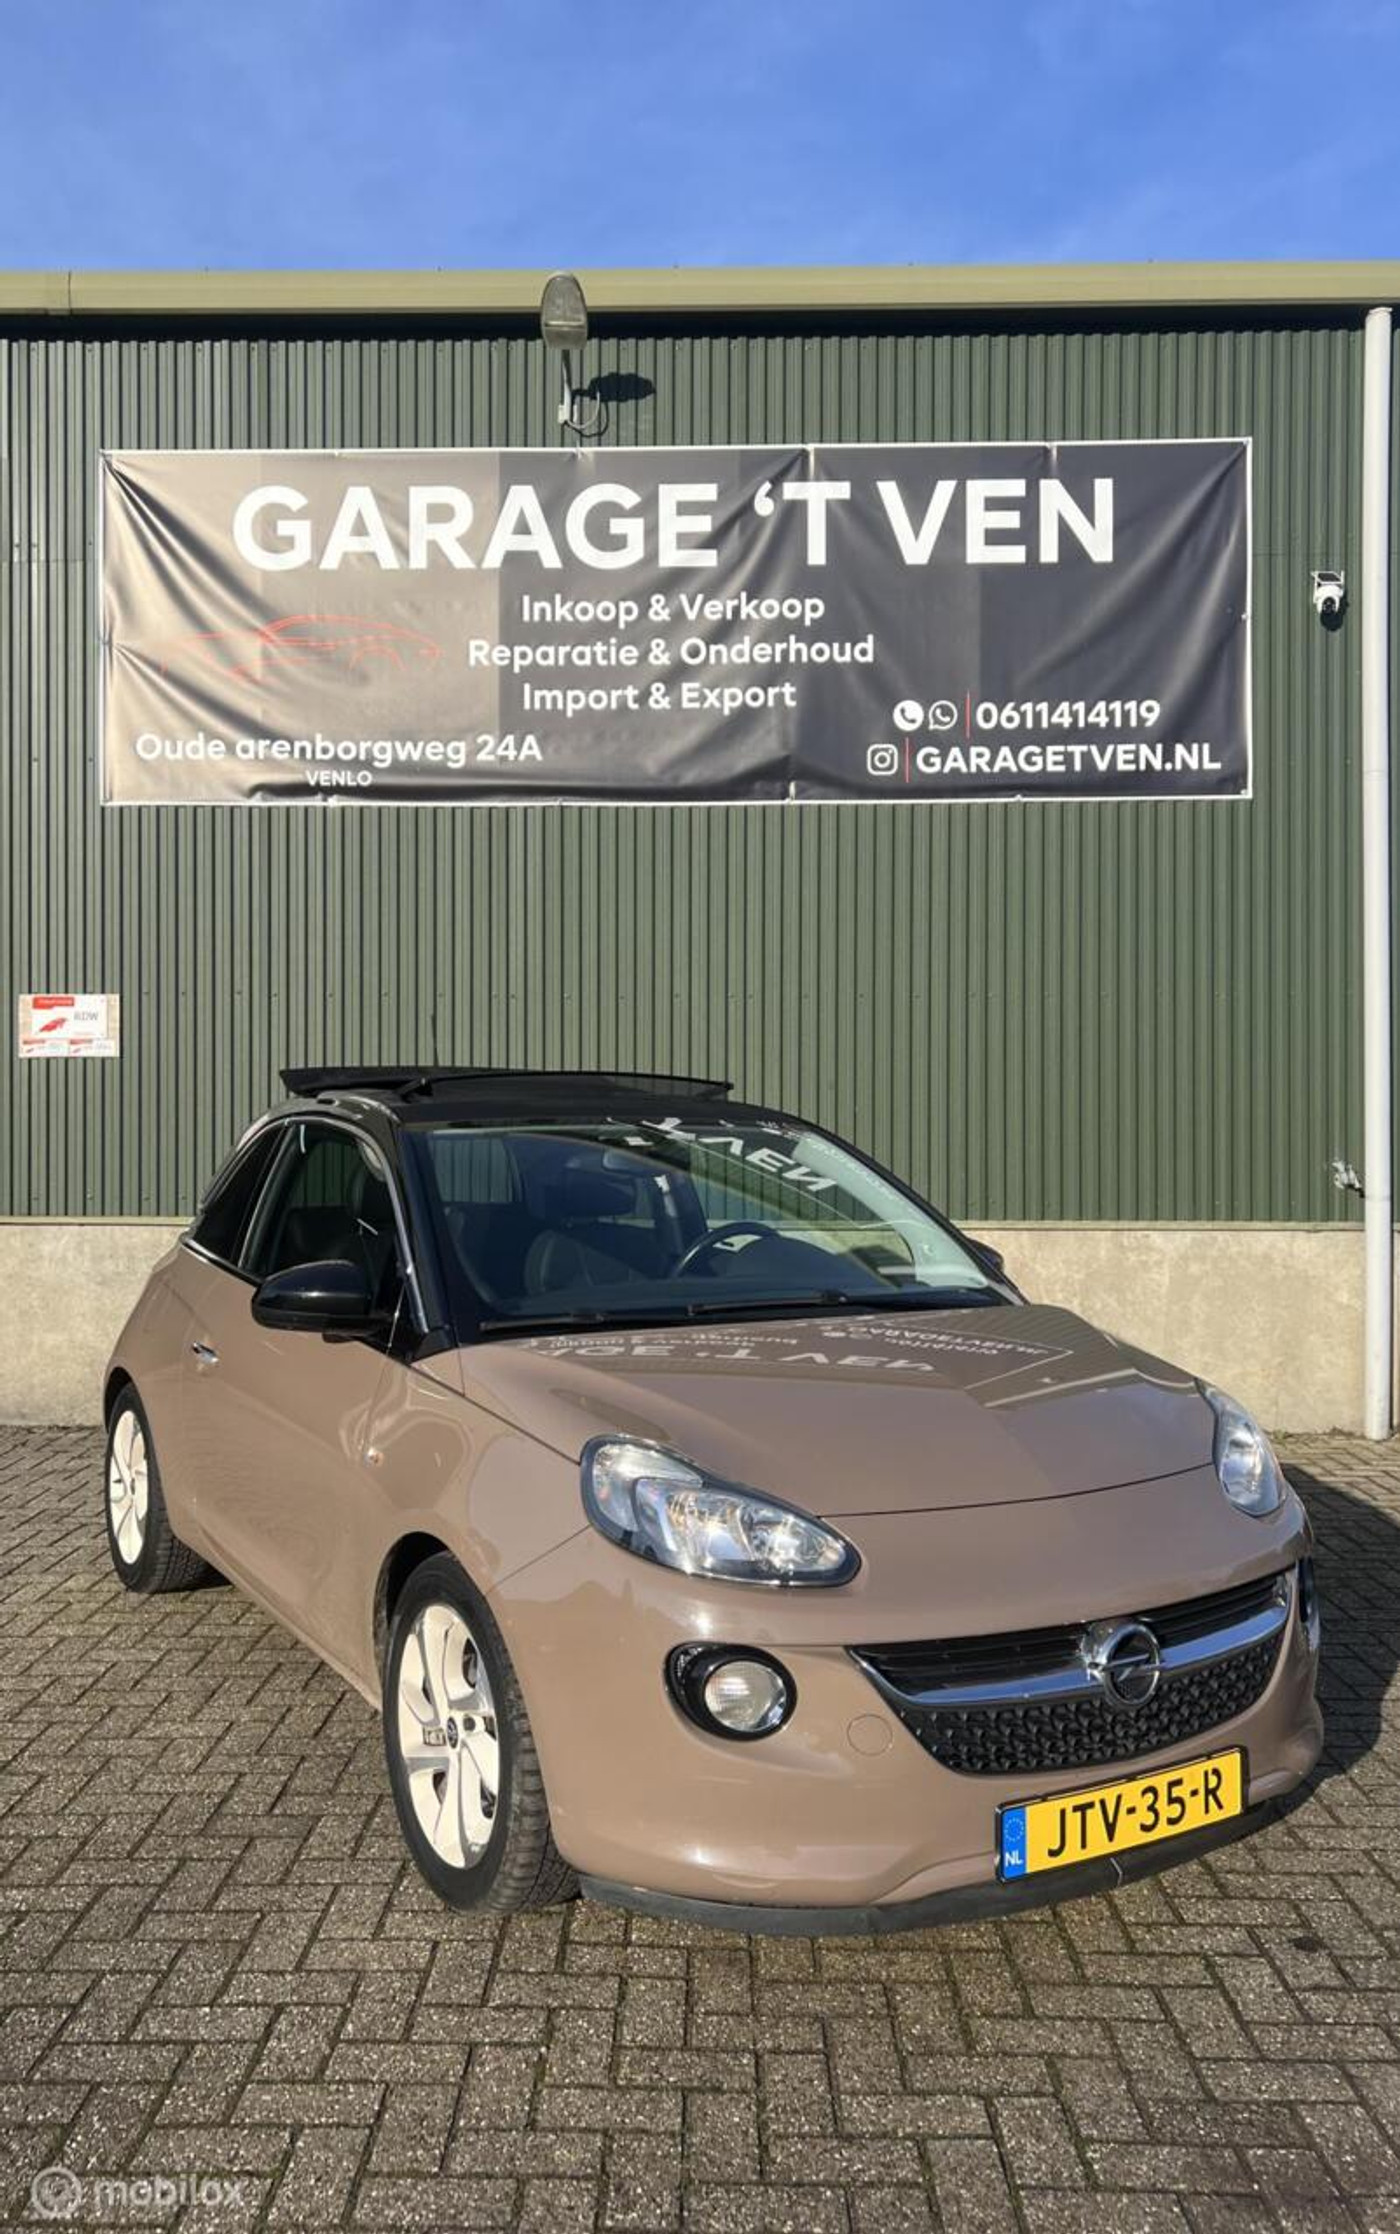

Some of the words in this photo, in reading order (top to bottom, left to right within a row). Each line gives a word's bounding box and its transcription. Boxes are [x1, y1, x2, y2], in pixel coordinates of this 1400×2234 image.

[233, 484, 718, 571] GARAGE
[877, 478, 1114, 565] VEN
[523, 594, 639, 629] Inkoop
[648, 595, 671, 622] &
[680, 592, 825, 626] Verkoop
[469, 637, 639, 673] Reparatie
[648, 639, 671, 665] &
[681, 634, 874, 665] Onderhoud
[523, 683, 639, 715] Import
[648, 683, 671, 710] &
[682, 682, 797, 716] Export
[976, 699, 1161, 730] 0611414119
[136, 732, 226, 760] Oude
[235, 734, 466, 768] arenborgweg
[476, 734, 543, 761] 24A
[916, 742, 1222, 774] GARAGETVEN.NL
[306, 770, 373, 786] VENLO
[1047, 1766, 1224, 1858] JTV-35-R
[1004, 1849, 1024, 1866] NL
